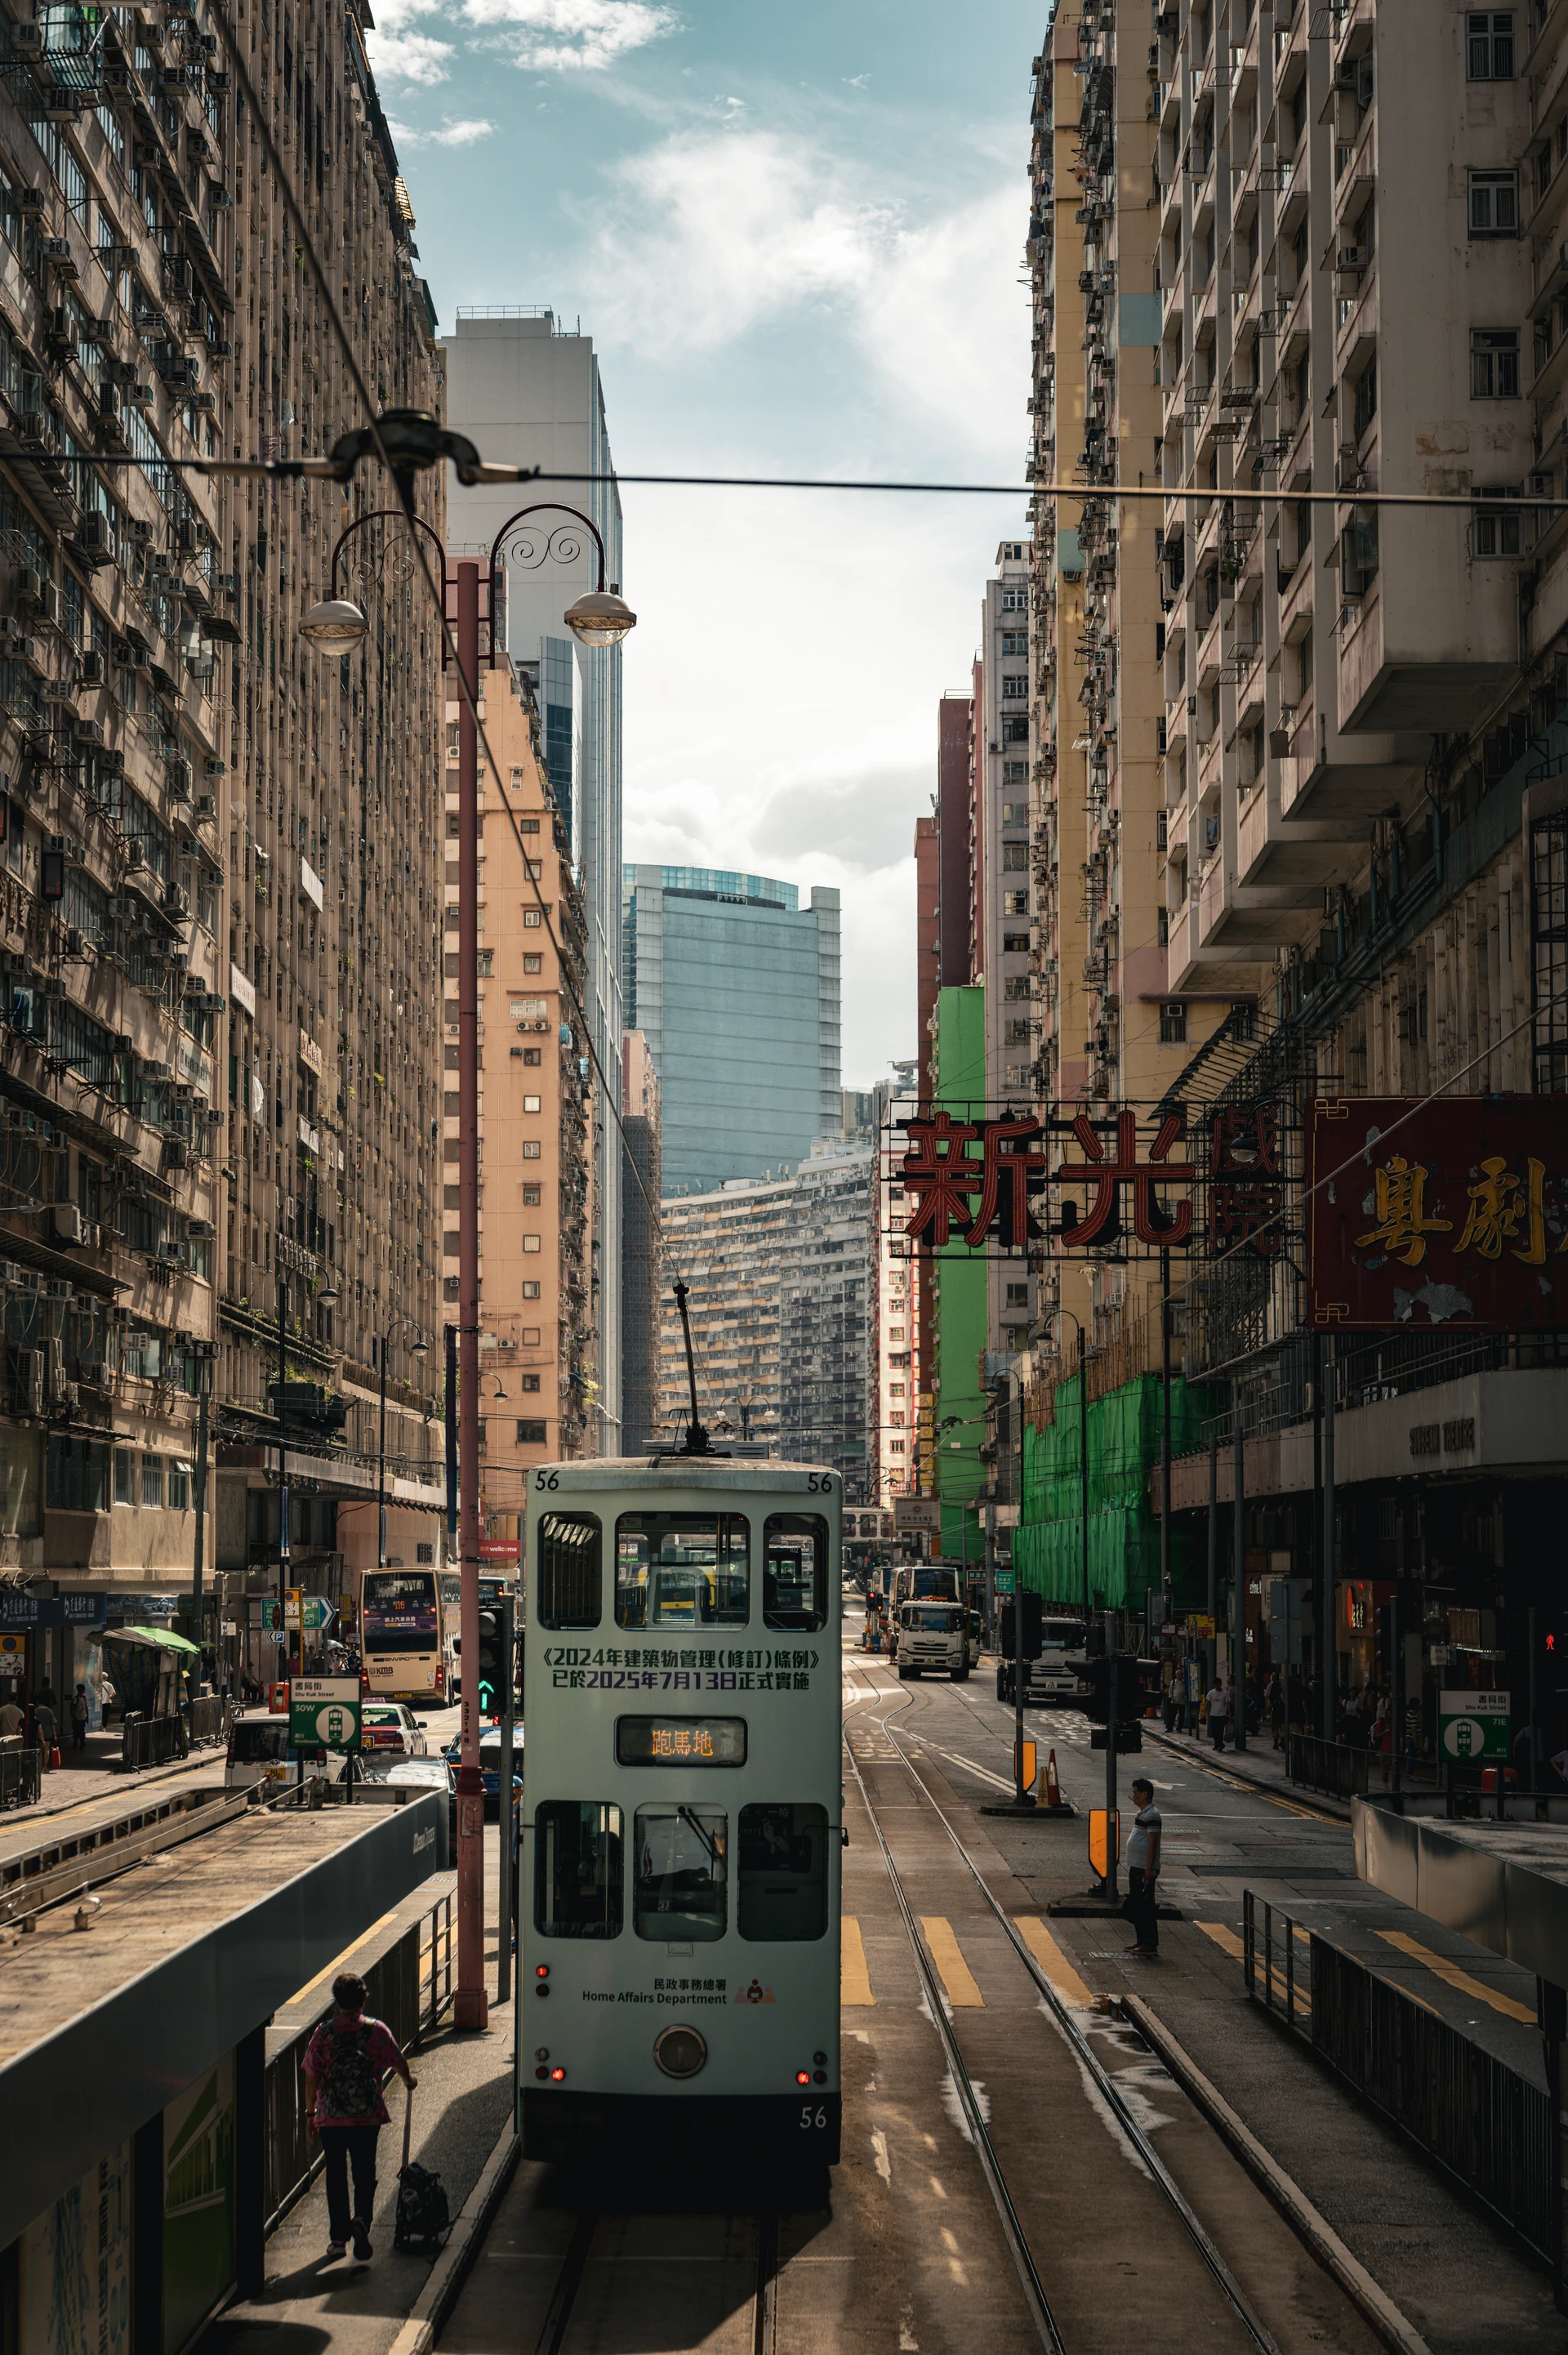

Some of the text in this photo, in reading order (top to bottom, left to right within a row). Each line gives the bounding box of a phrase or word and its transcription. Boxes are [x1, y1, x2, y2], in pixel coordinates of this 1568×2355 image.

[904, 1110, 1196, 1247] 新光
[1353, 1156, 1568, 1266] 粵劇
[535, 1470, 559, 1491] 56
[807, 1473, 832, 1493] 56
[376, 1666, 394, 1675] KMB
[553, 1670, 810, 1690] 已於2025年7月13日正式實施
[295, 1682, 322, 1691] 書局街
[295, 1704, 315, 1712] 30W
[1479, 1695, 1506, 1703] 書局街
[652, 1730, 713, 1756] 跑馬地
[654, 1978, 727, 1991] 民政事務總署
[582, 1991, 727, 2006] Home Affairs Department
[800, 2106, 827, 2129] 56
